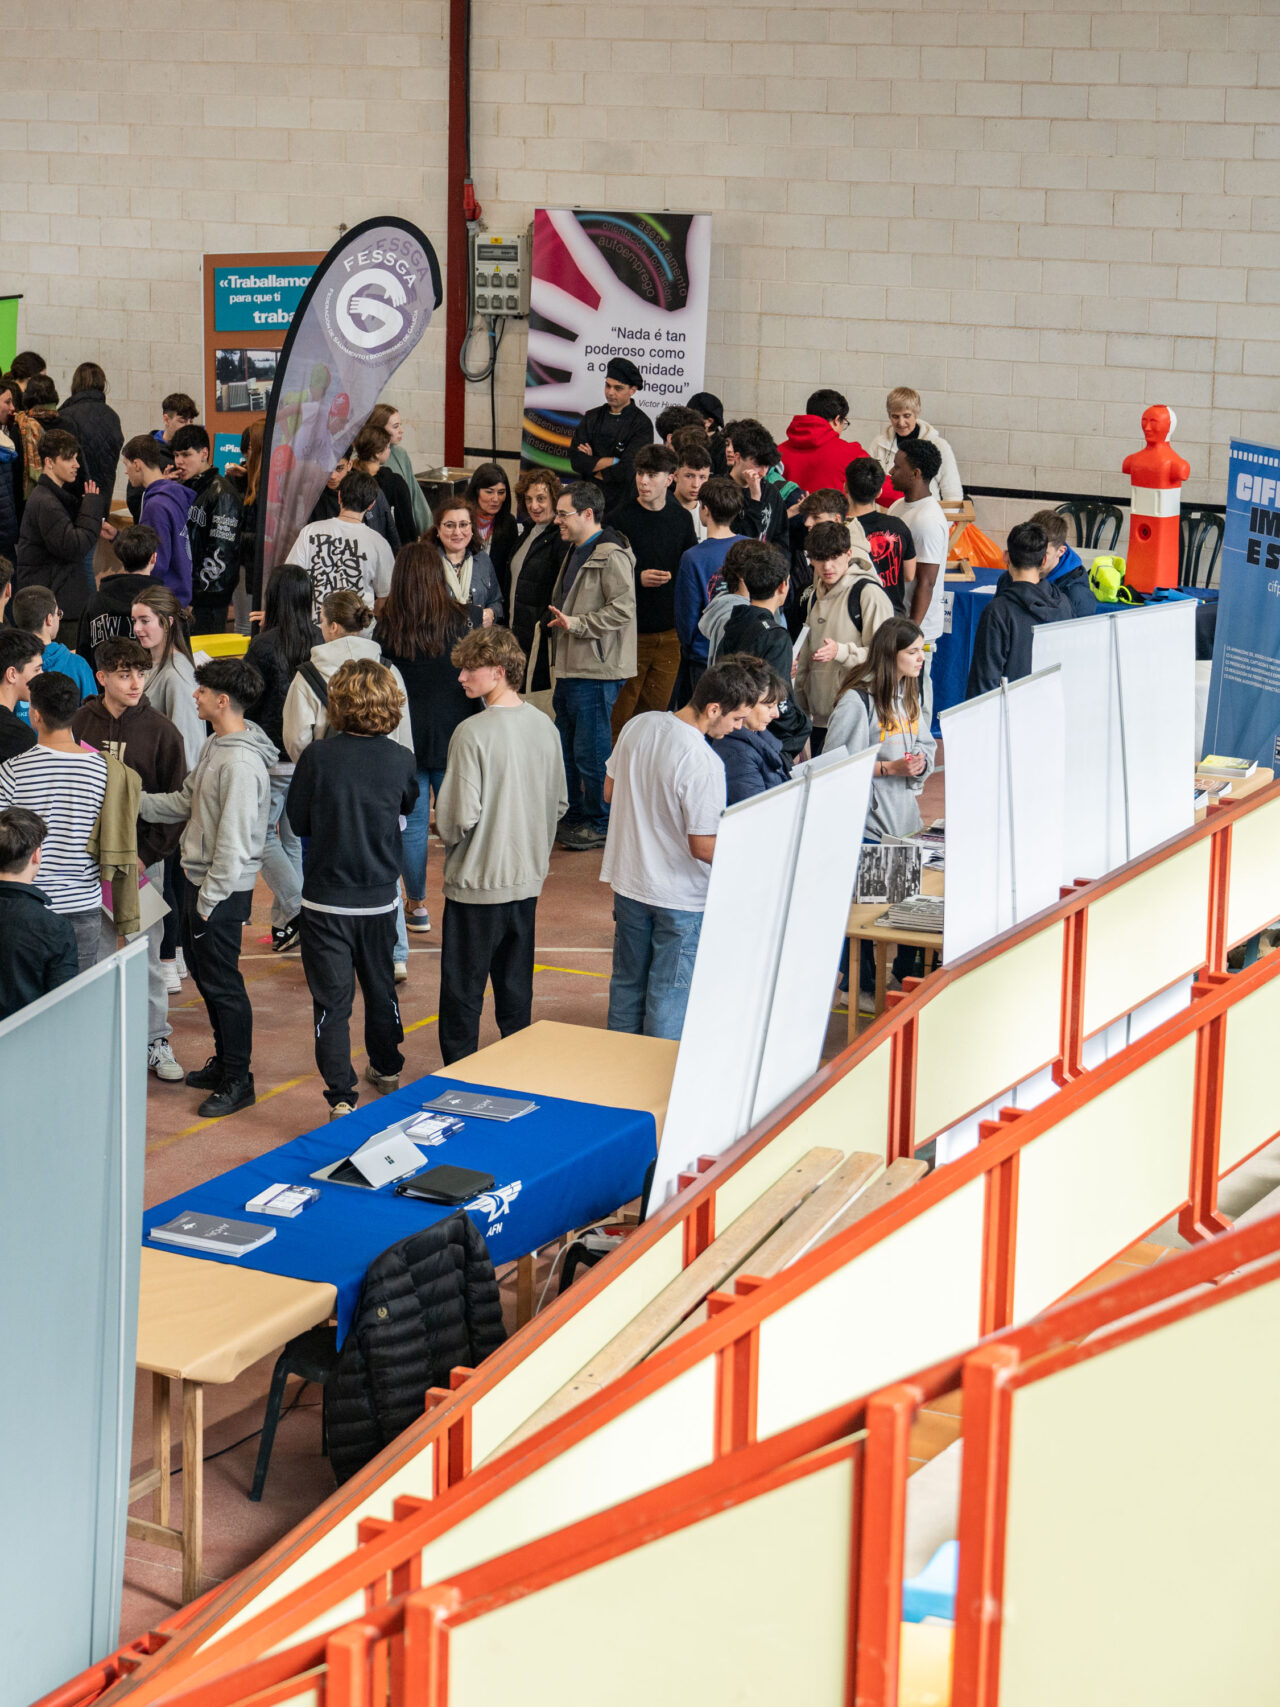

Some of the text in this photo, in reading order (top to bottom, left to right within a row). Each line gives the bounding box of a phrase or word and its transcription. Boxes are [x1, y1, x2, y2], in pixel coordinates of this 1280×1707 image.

[343, 250, 417, 288] FESSGA
[597, 236, 655, 297] autoemprego
[229, 294, 252, 305] para
[253, 293, 273, 304] que
[611, 326, 686, 342] “Nada é tan
[584, 344, 685, 360] poderoso como
[587, 361, 595, 372] a
[638, 400, 661, 408] Victor
[1246, 537, 1262, 566] E
[486, 1222, 503, 1238] AFN
